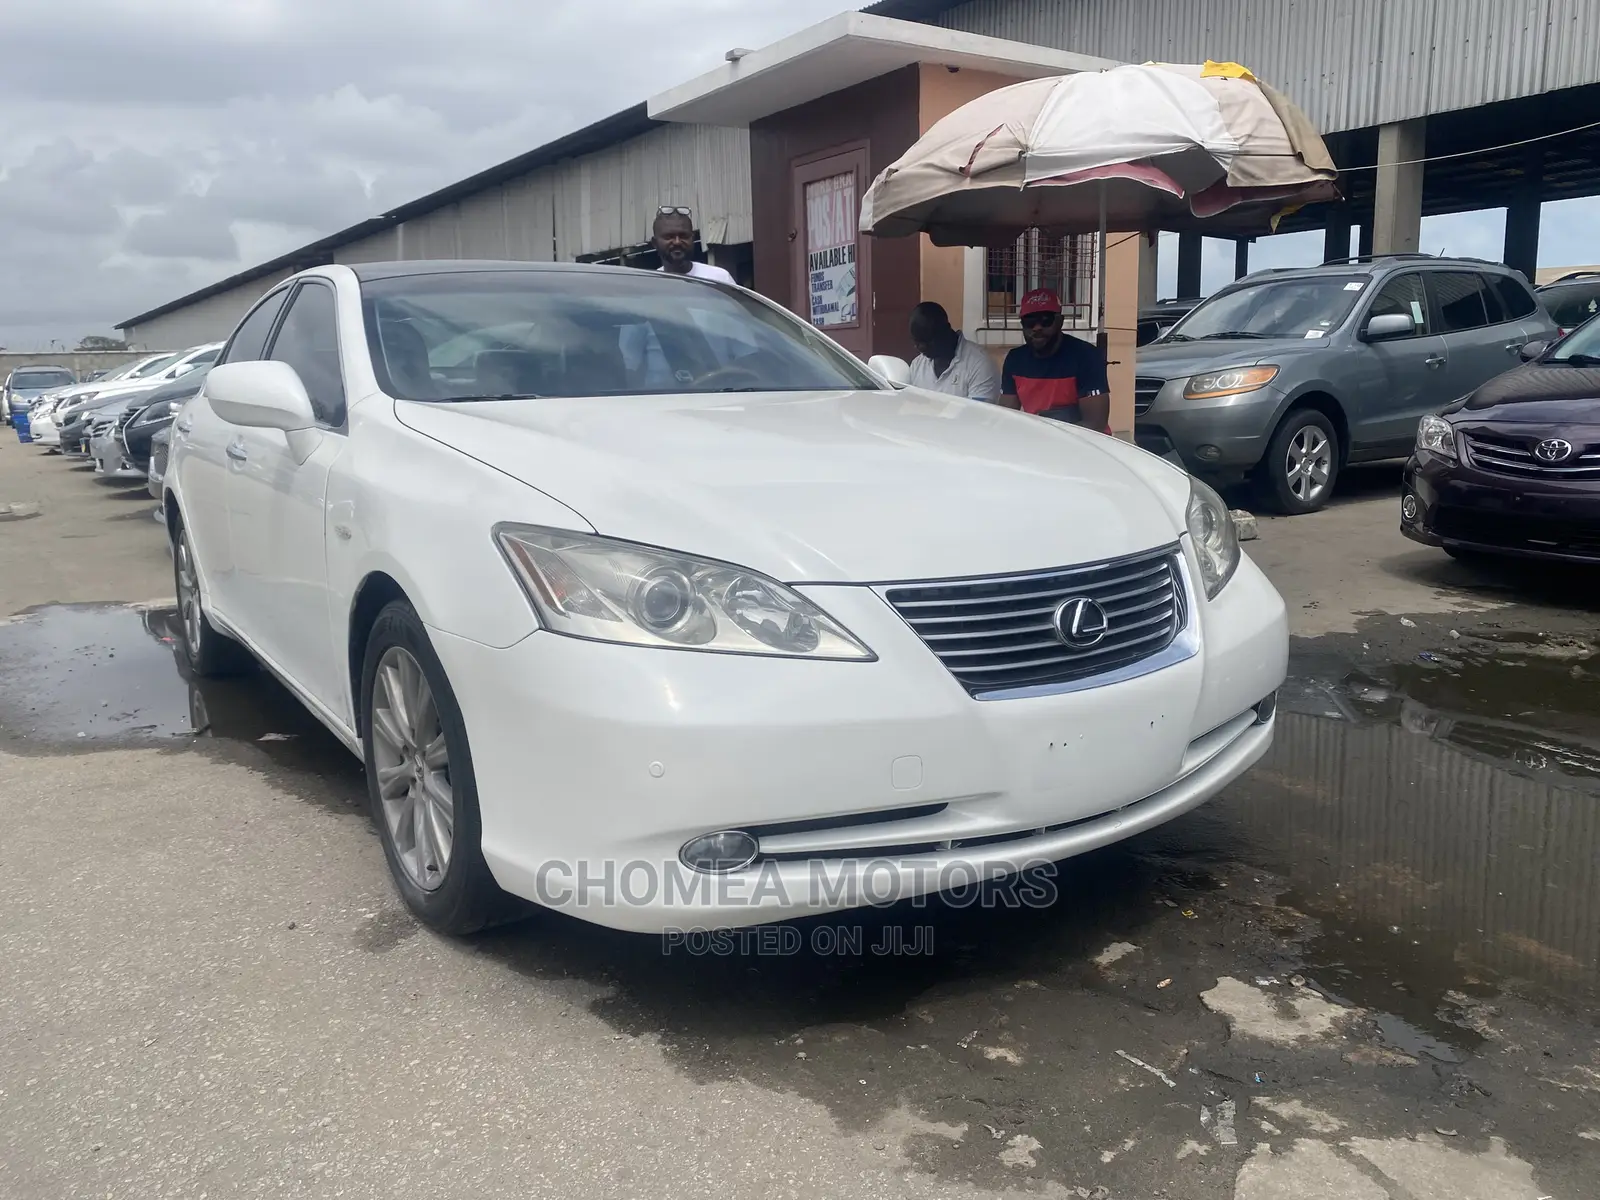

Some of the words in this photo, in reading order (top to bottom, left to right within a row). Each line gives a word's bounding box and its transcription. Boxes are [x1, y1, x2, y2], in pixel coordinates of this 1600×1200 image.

[810, 246, 846, 272] AVAILABLE
[811, 271, 824, 283] FUNDS
[812, 280, 833, 293] TRANSFER
